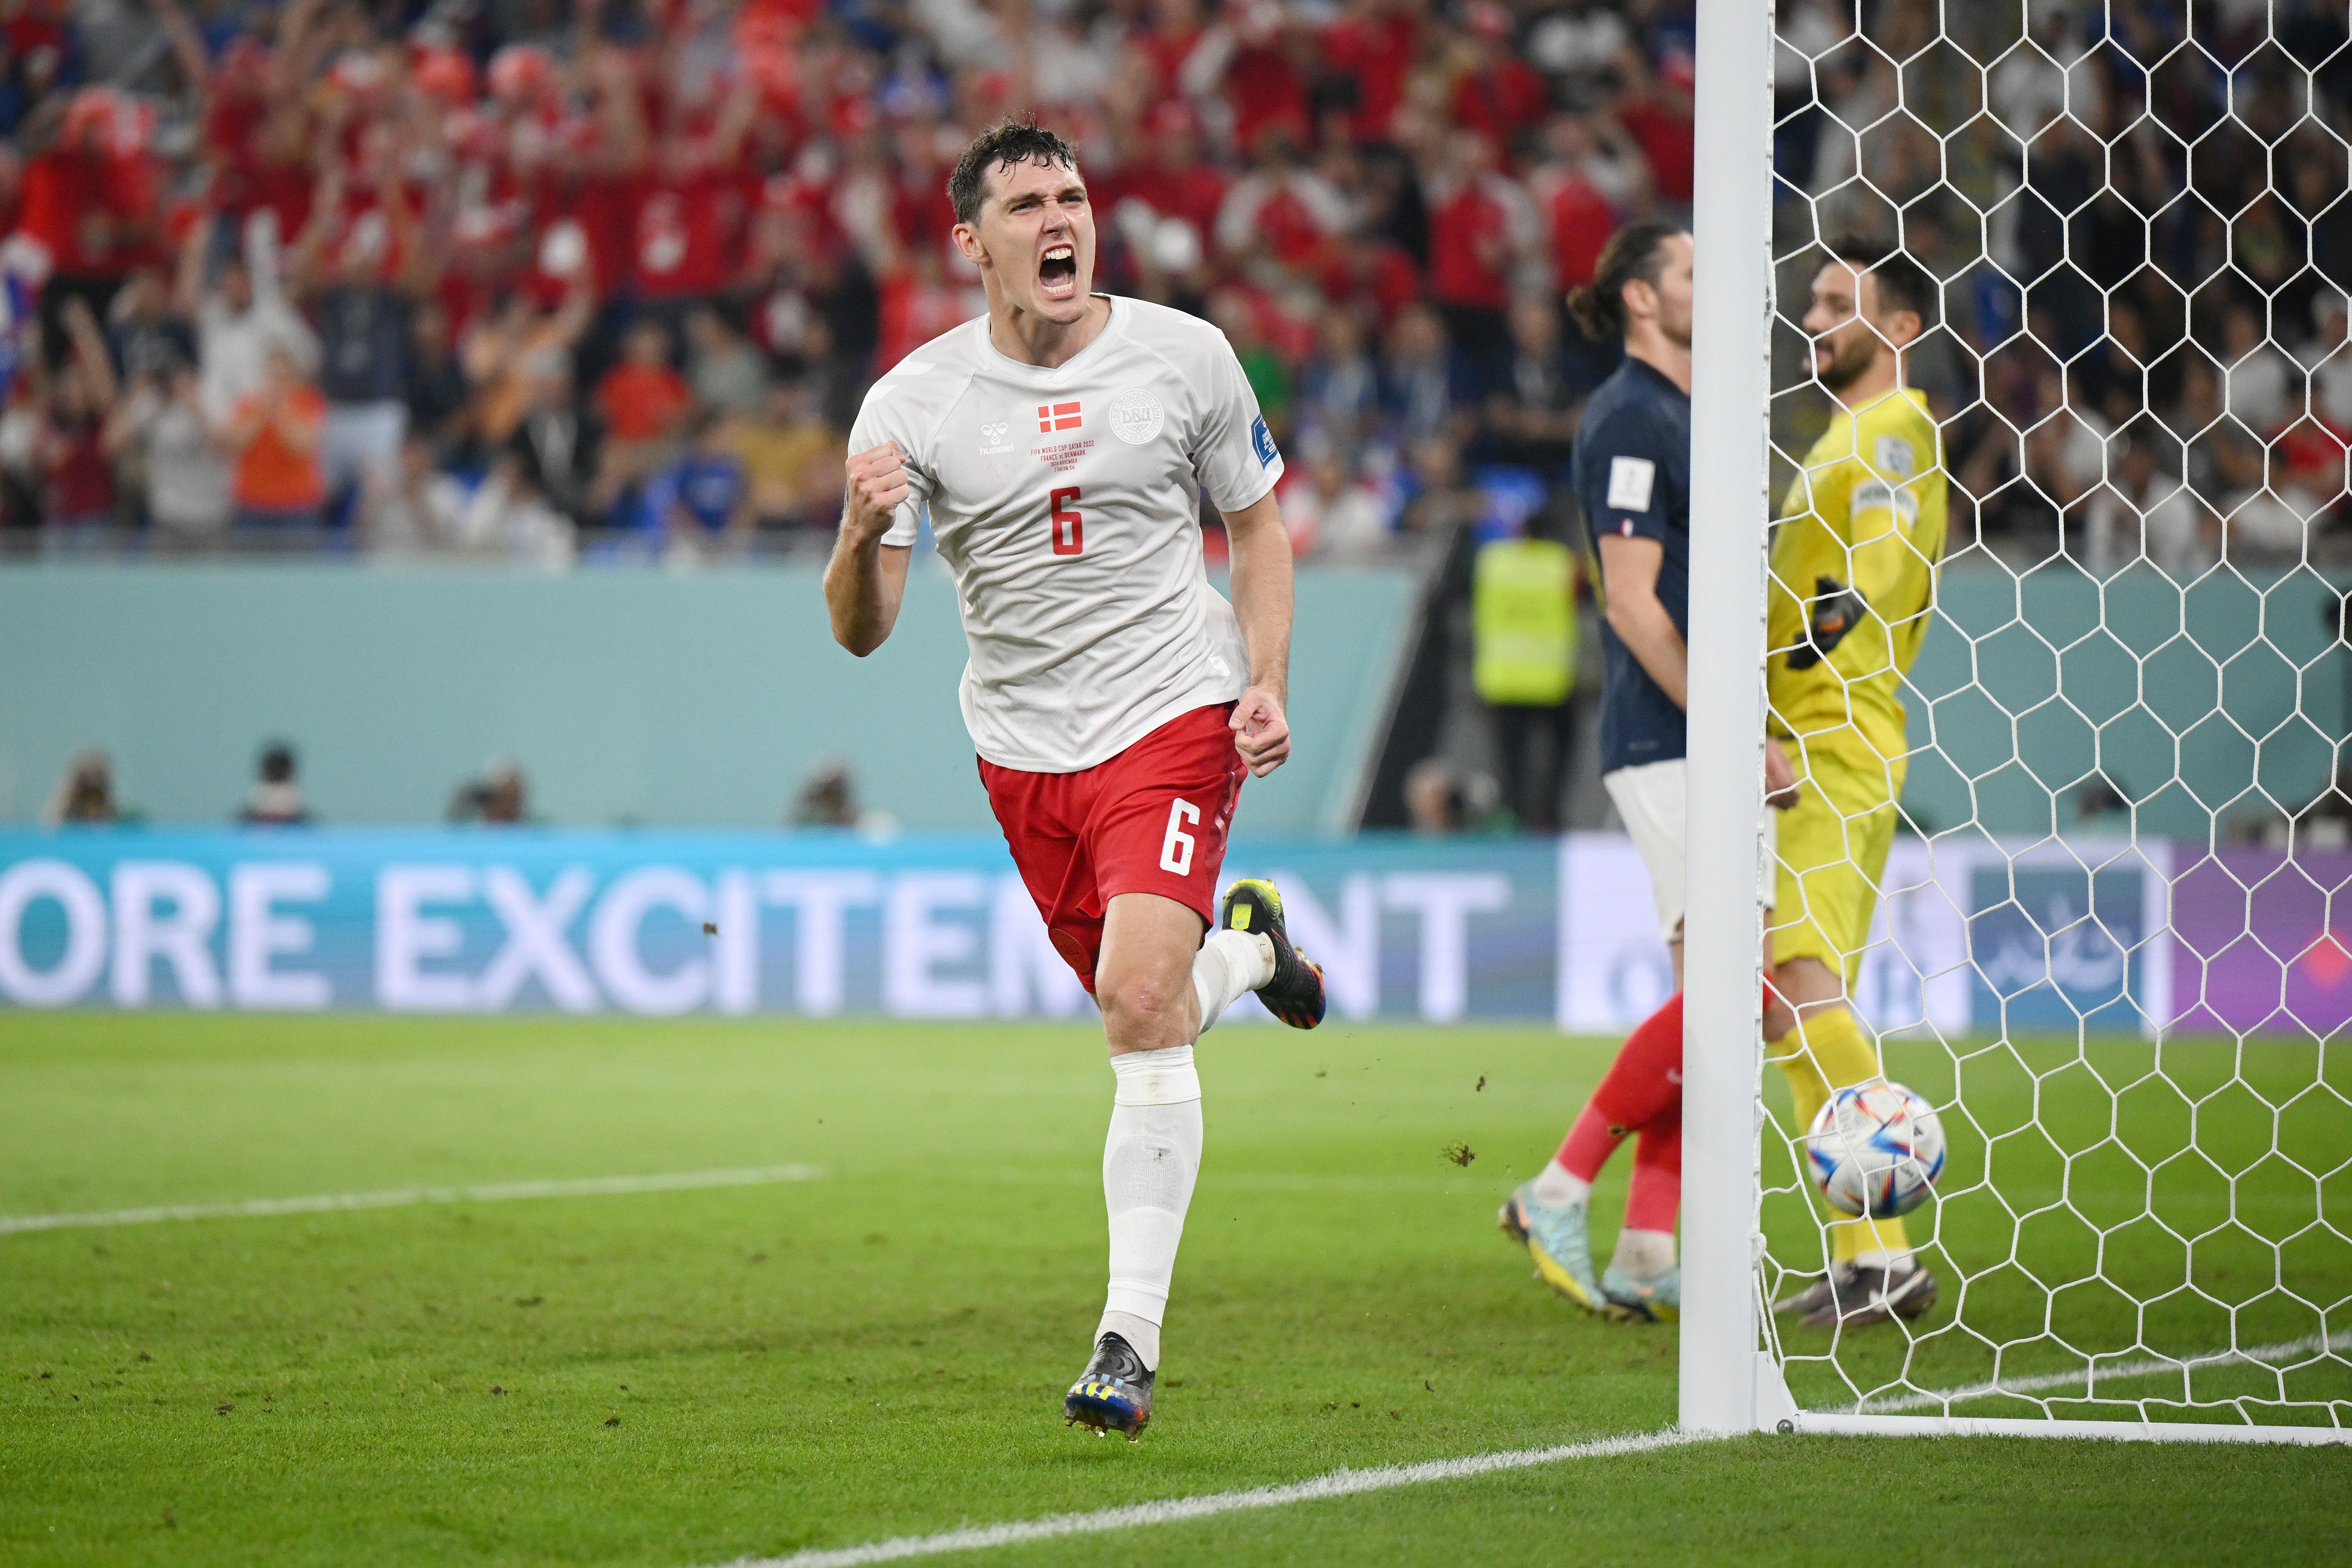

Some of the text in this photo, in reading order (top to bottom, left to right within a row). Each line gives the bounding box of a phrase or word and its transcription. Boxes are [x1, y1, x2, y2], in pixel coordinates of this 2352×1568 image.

[1113, 408, 1126, 436] DANSK
[979, 442, 1014, 455] hummel
[1040, 454, 1058, 462] FRANCE
[1064, 450, 1086, 458] DENMARK
[1050, 486, 1083, 555] 6
[1159, 797, 1201, 876] 6
[0, 857, 330, 1009] ORE
